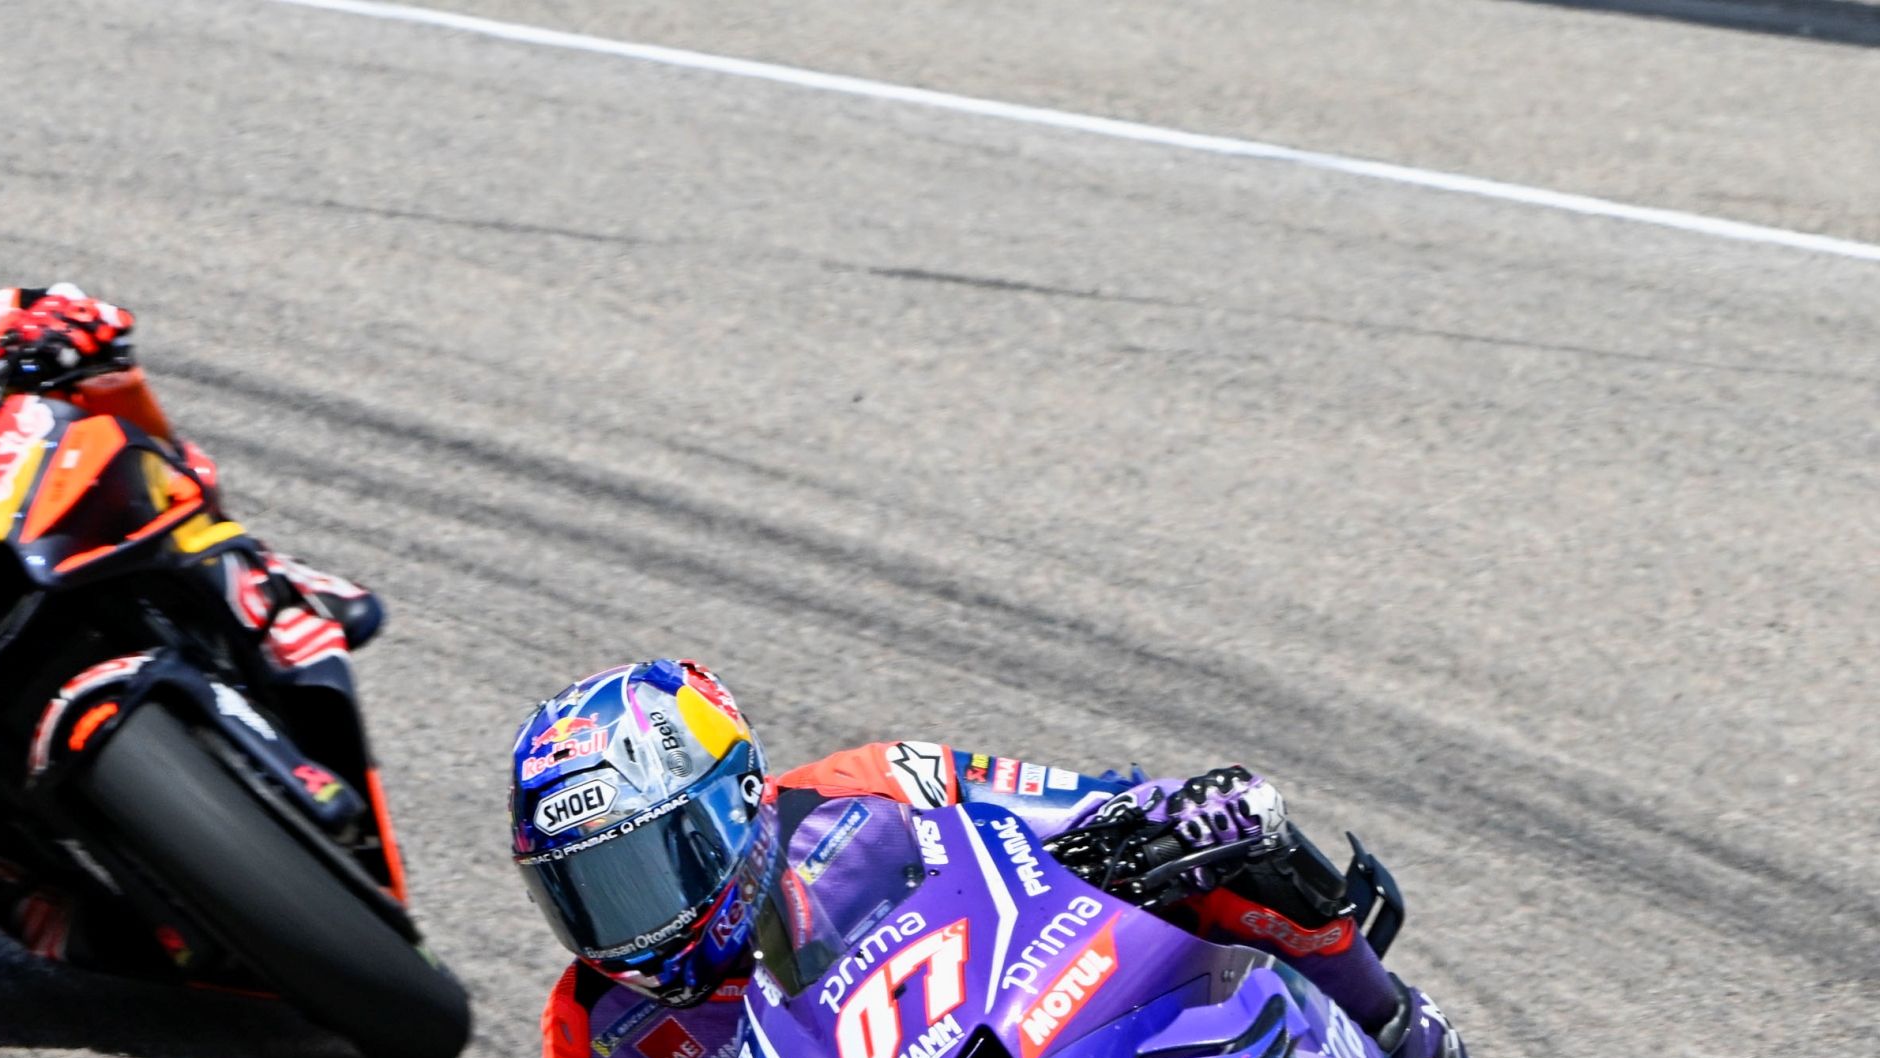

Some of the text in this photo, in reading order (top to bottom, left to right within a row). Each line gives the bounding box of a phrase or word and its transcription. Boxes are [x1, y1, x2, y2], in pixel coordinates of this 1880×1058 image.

[543, 785, 605, 827] SHOEI
[564, 832, 618, 856] PRAMAC
[634, 793, 689, 827] PRAMAC
[991, 817, 1050, 896] PRAMAC
[635, 906, 697, 948] Otomotiv
[820, 910, 927, 1013] prima
[1002, 895, 1102, 994] prima
[1022, 948, 1113, 1046] MOTUL
